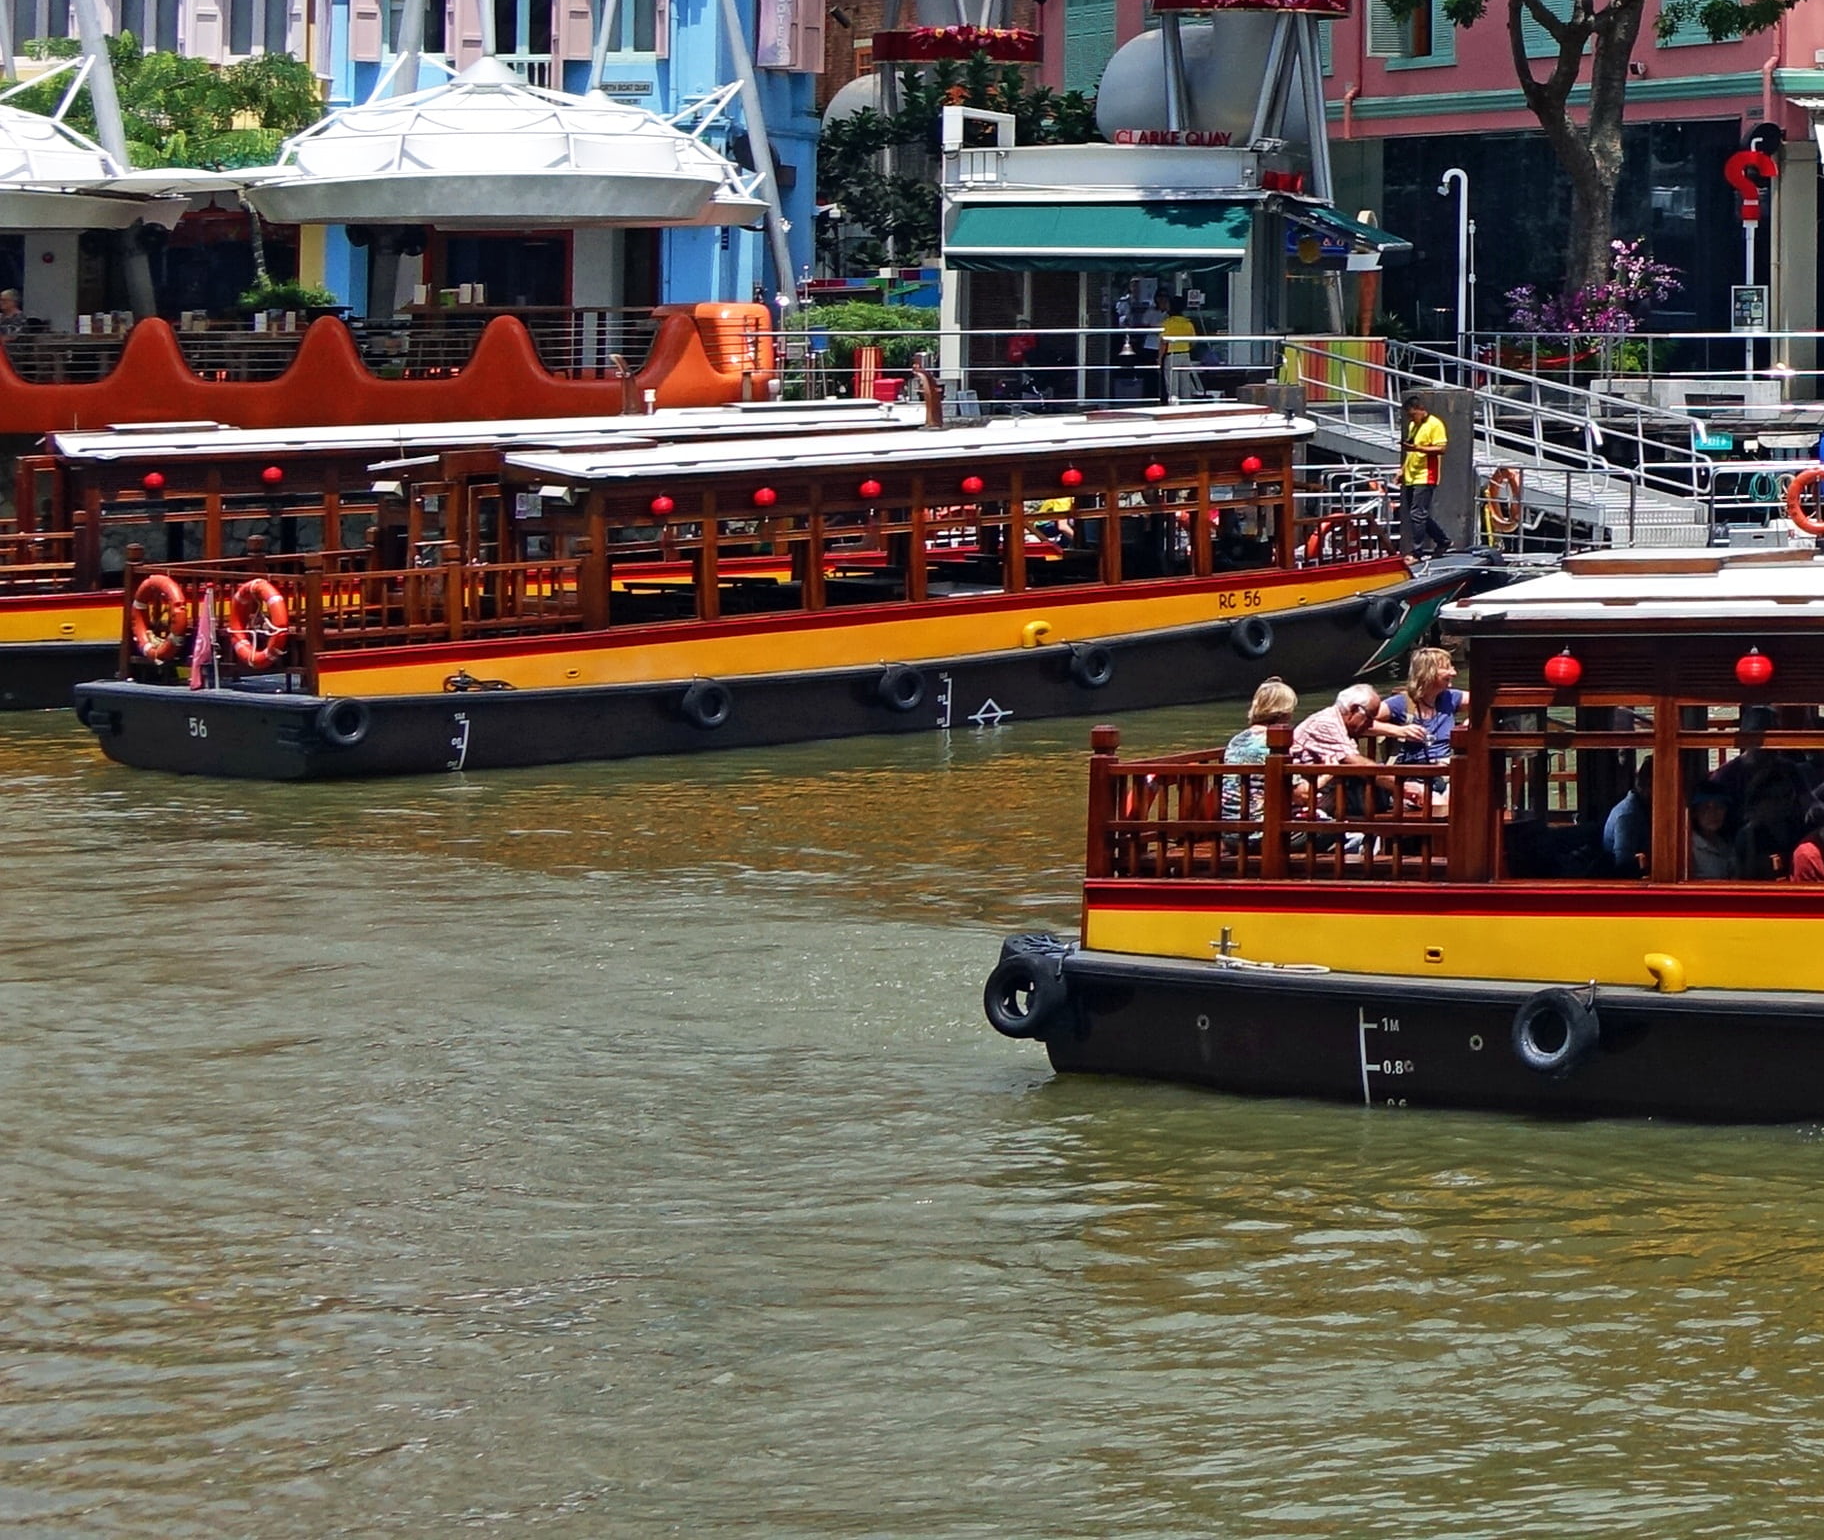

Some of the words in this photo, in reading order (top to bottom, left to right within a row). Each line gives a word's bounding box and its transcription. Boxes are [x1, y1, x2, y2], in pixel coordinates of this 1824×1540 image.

[1115, 129, 1180, 146] CLARKE
[1185, 131, 1232, 147] QUAY
[1218, 593, 1237, 609] RC
[1243, 590, 1261, 608] 56
[189, 716, 208, 738] 56
[1382, 1017, 1400, 1032] 1M
[1383, 1060, 1404, 1075] 0.8
